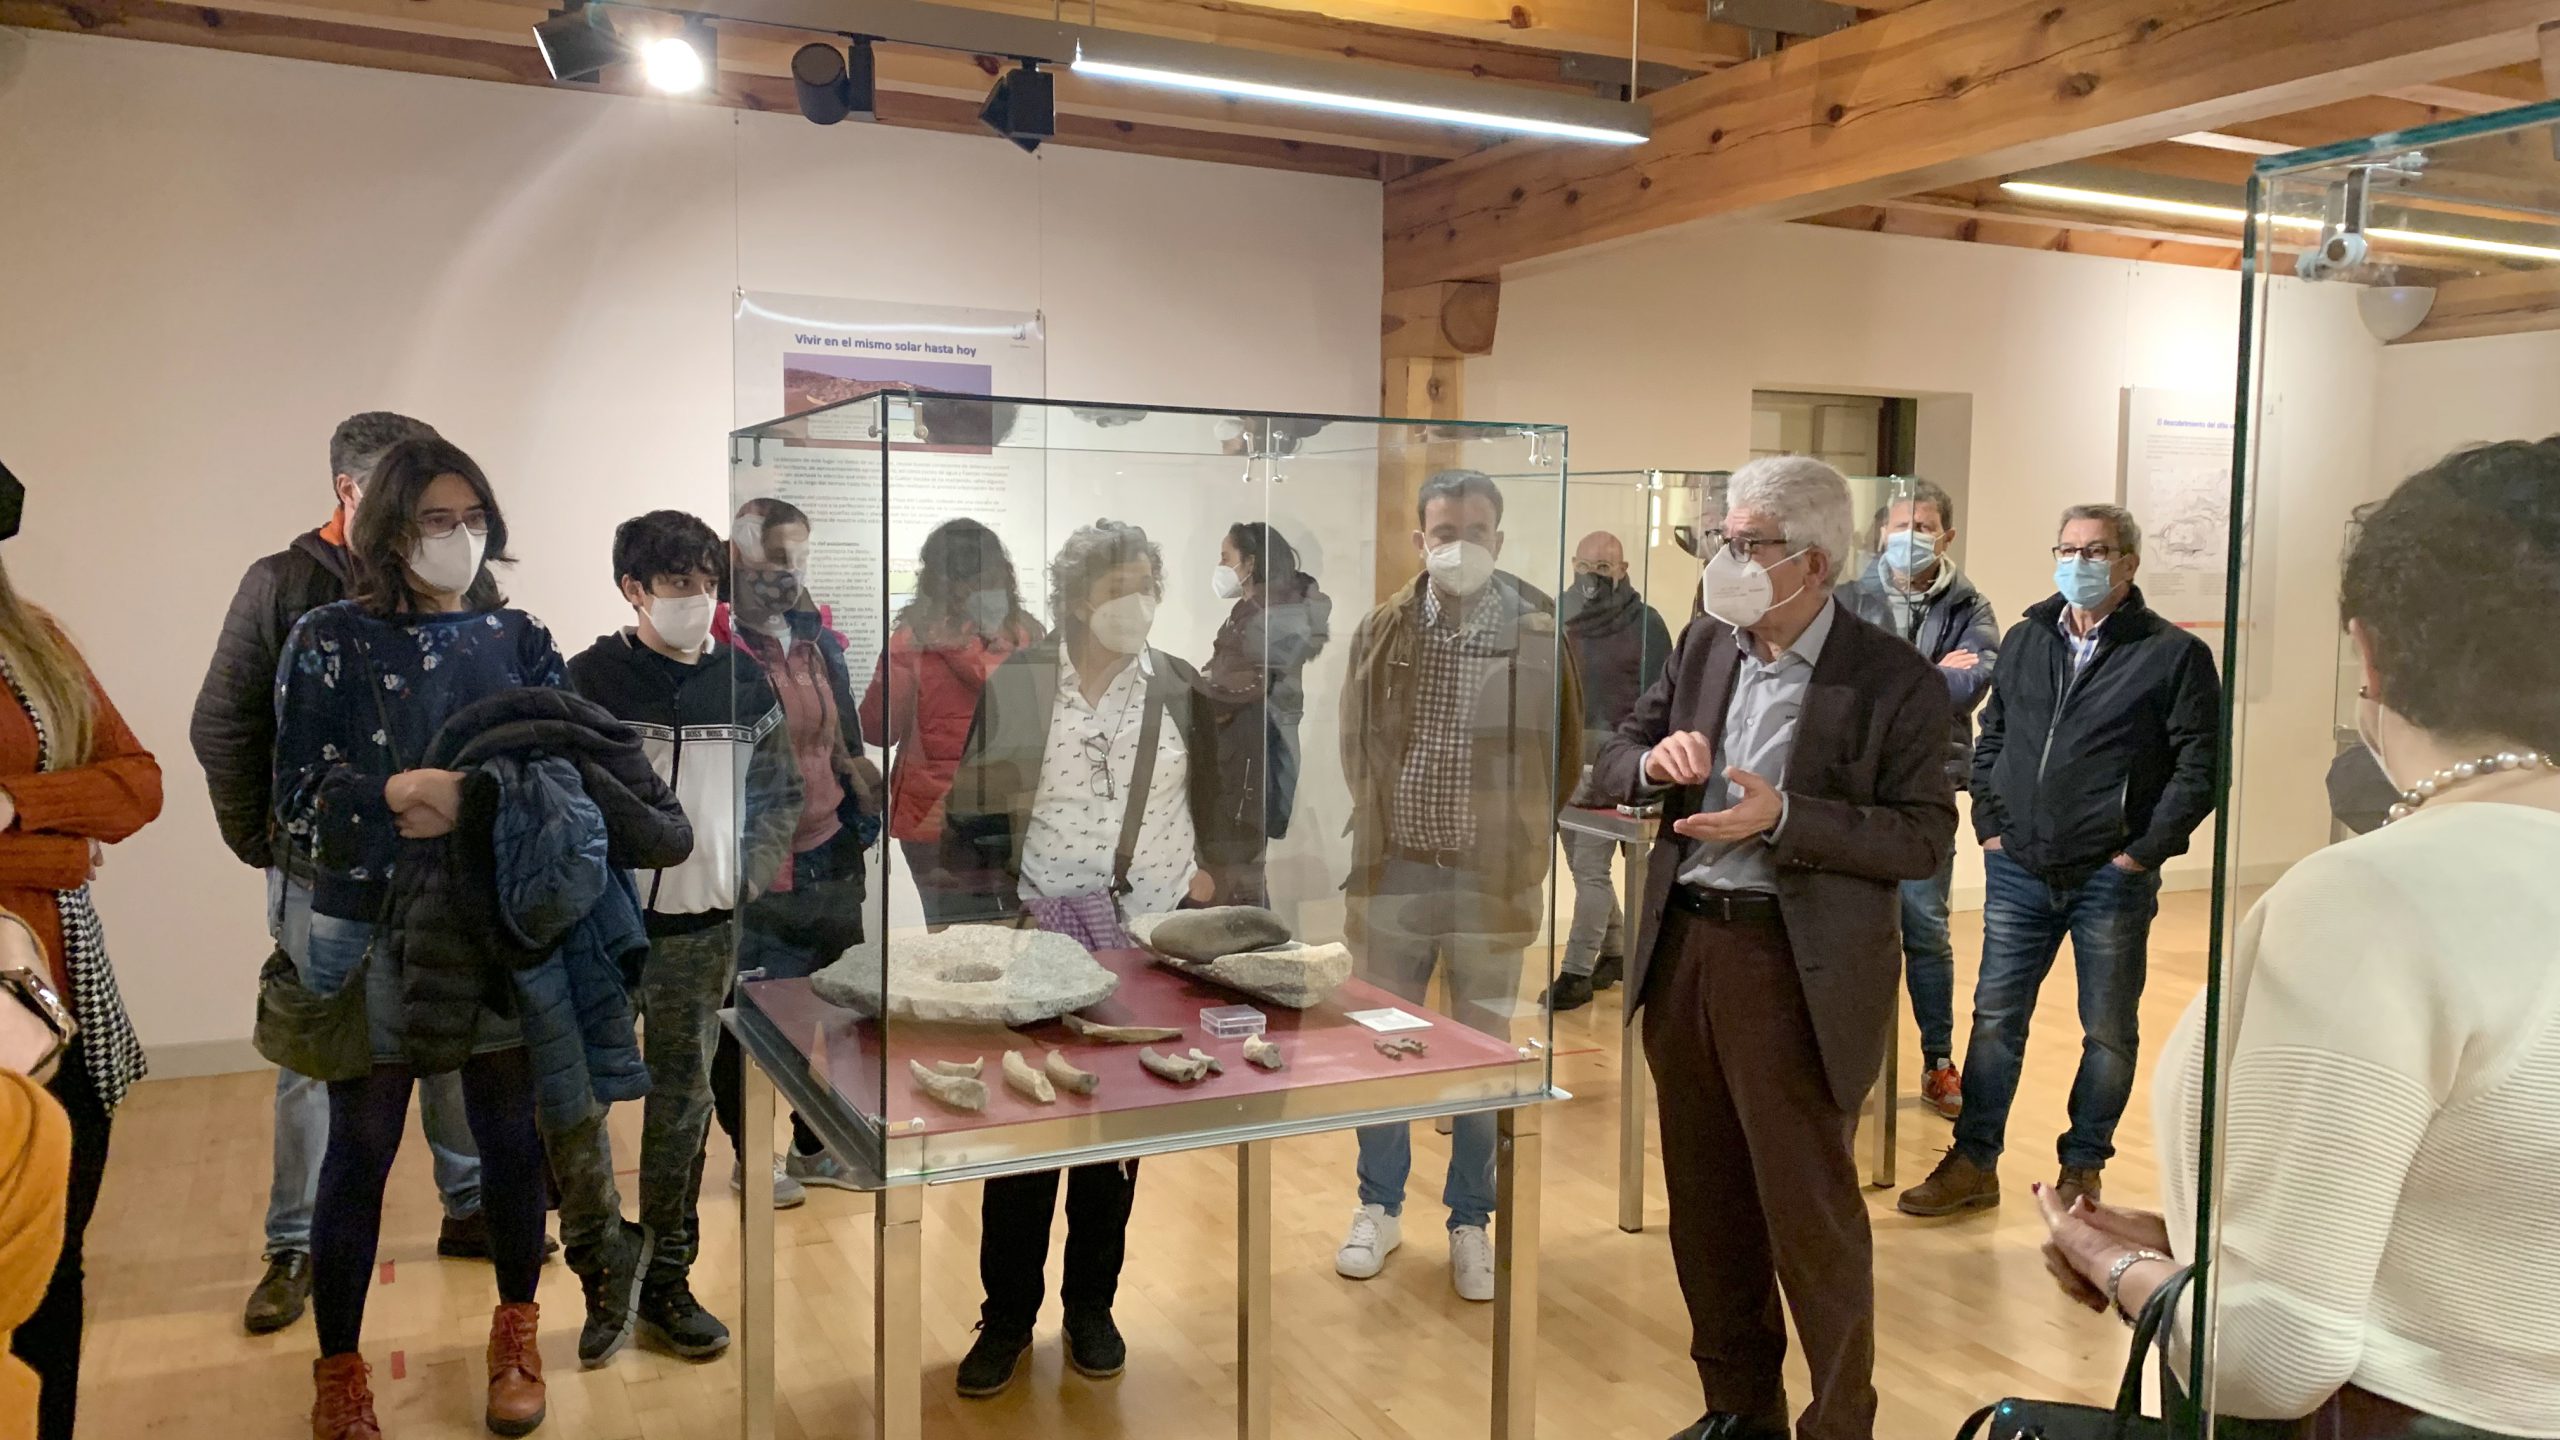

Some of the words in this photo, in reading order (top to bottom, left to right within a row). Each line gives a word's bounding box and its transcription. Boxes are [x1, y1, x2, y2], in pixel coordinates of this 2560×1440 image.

[795, 334, 821, 346] Vivir
[824, 338, 838, 347] en
[841, 337, 852, 348] el
[855, 339, 892, 351] mismo
[895, 341, 921, 352] solar
[924, 343, 954, 355] hasta
[956, 345, 977, 358] hoy
